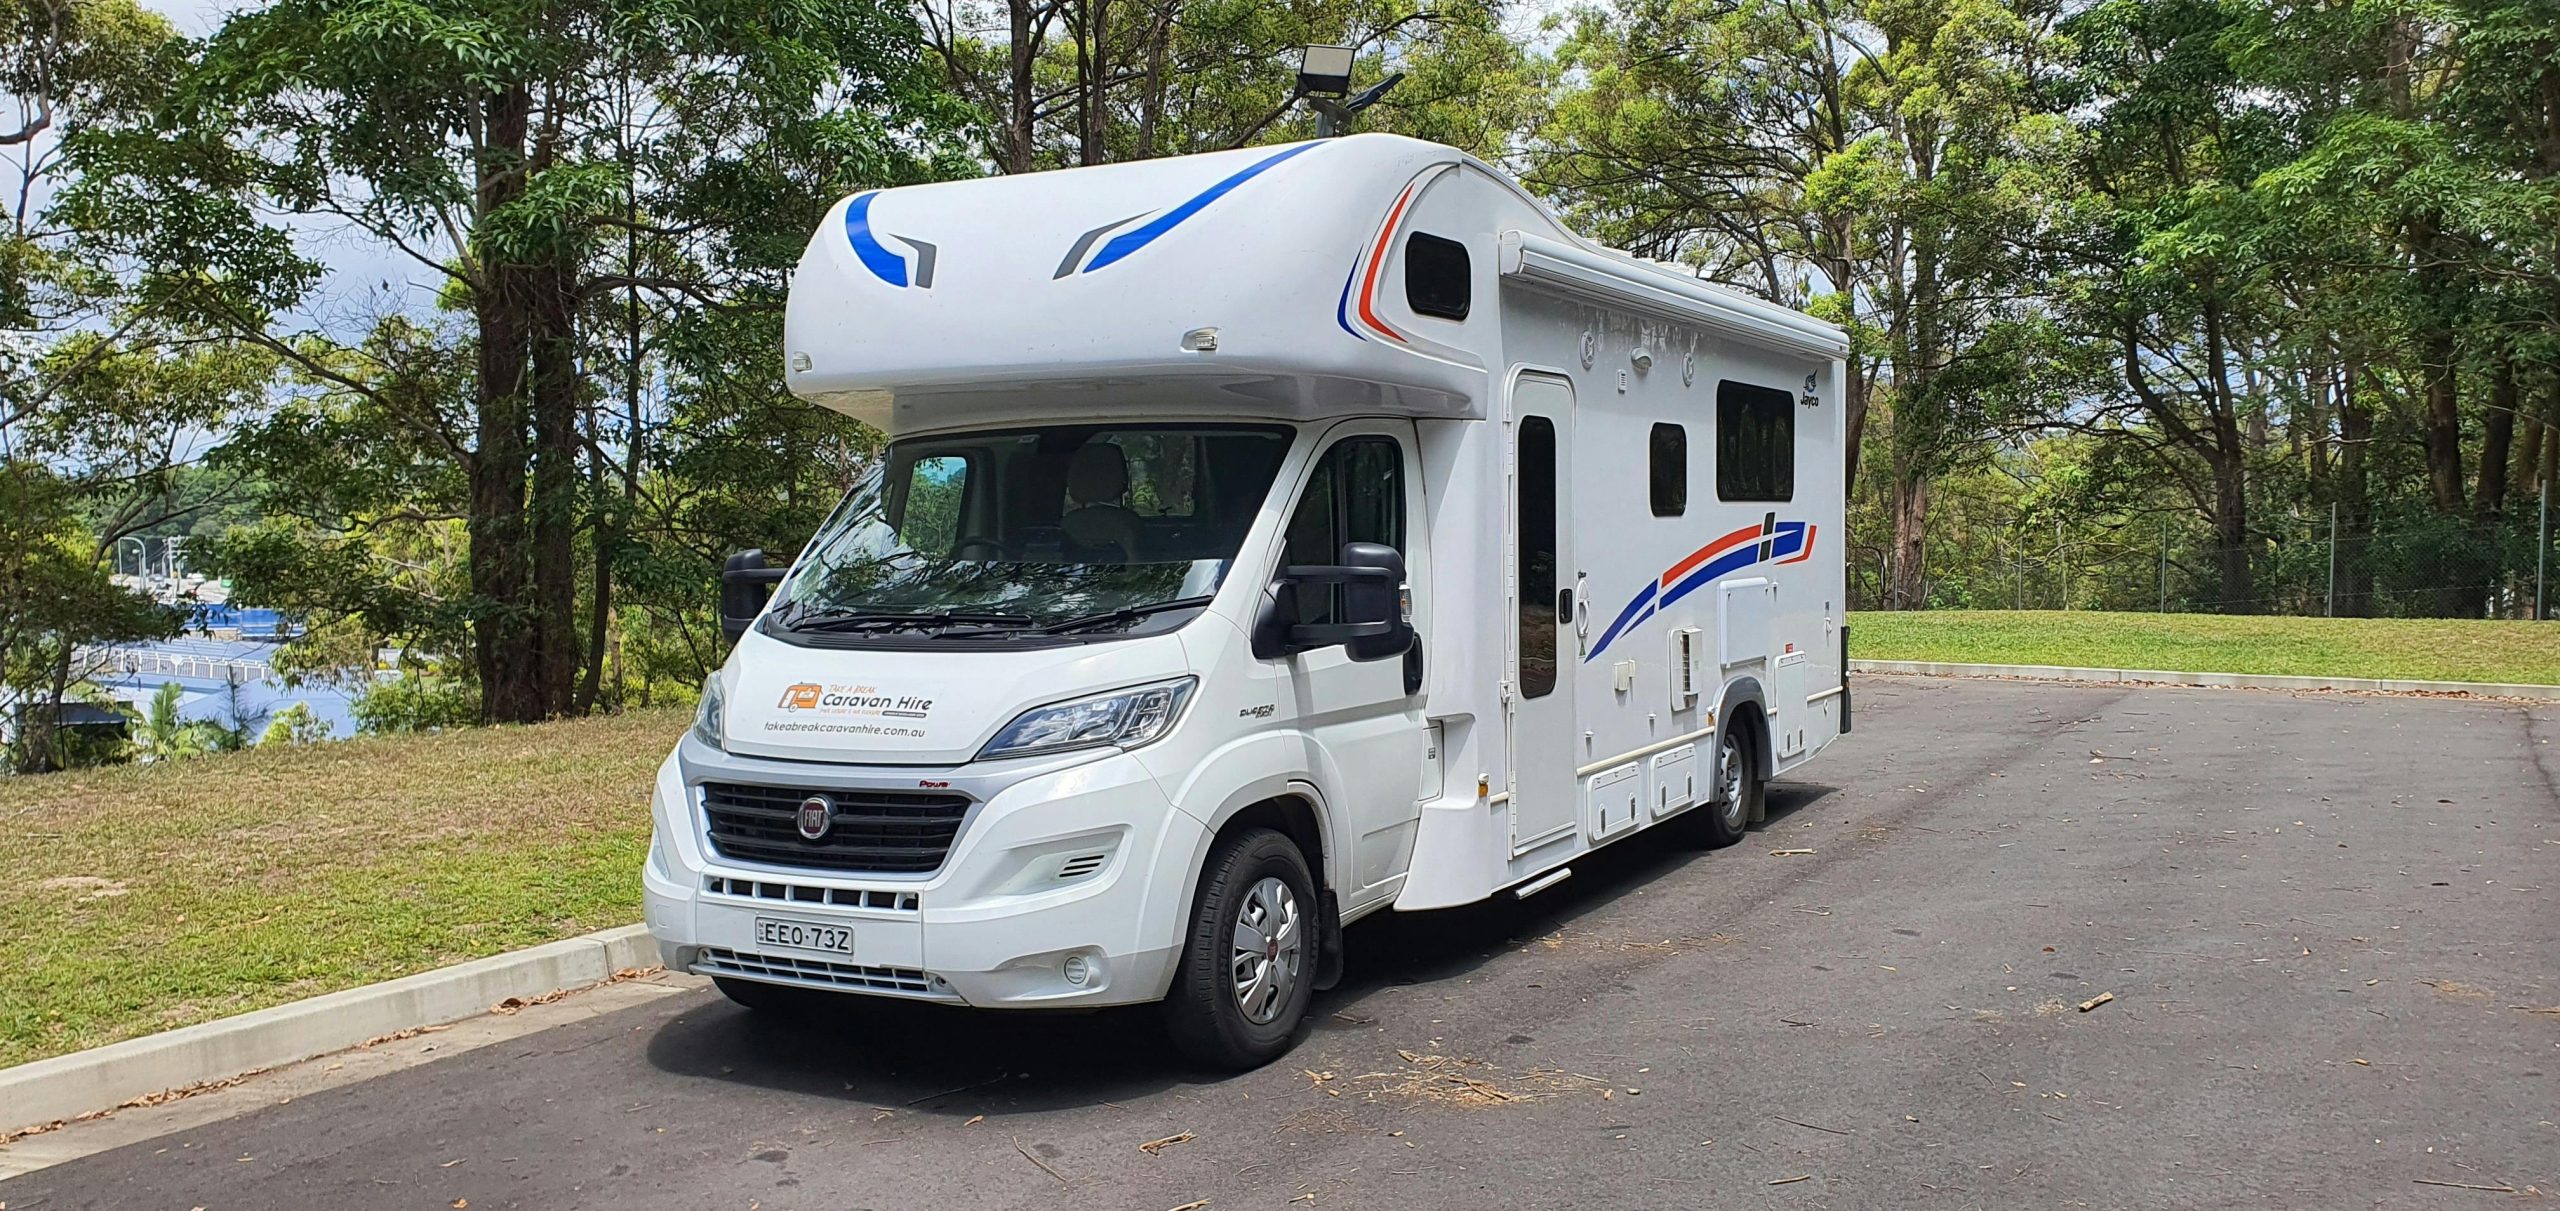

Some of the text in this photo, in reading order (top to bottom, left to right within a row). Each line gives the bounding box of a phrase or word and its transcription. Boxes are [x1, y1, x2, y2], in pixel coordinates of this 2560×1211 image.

[1800, 391, 1819, 409] Jayco
[822, 693, 933, 711] Caravan Hire
[764, 721, 925, 738] takeabreakcaravanhire.com.au
[804, 809, 824, 828] FIAT
